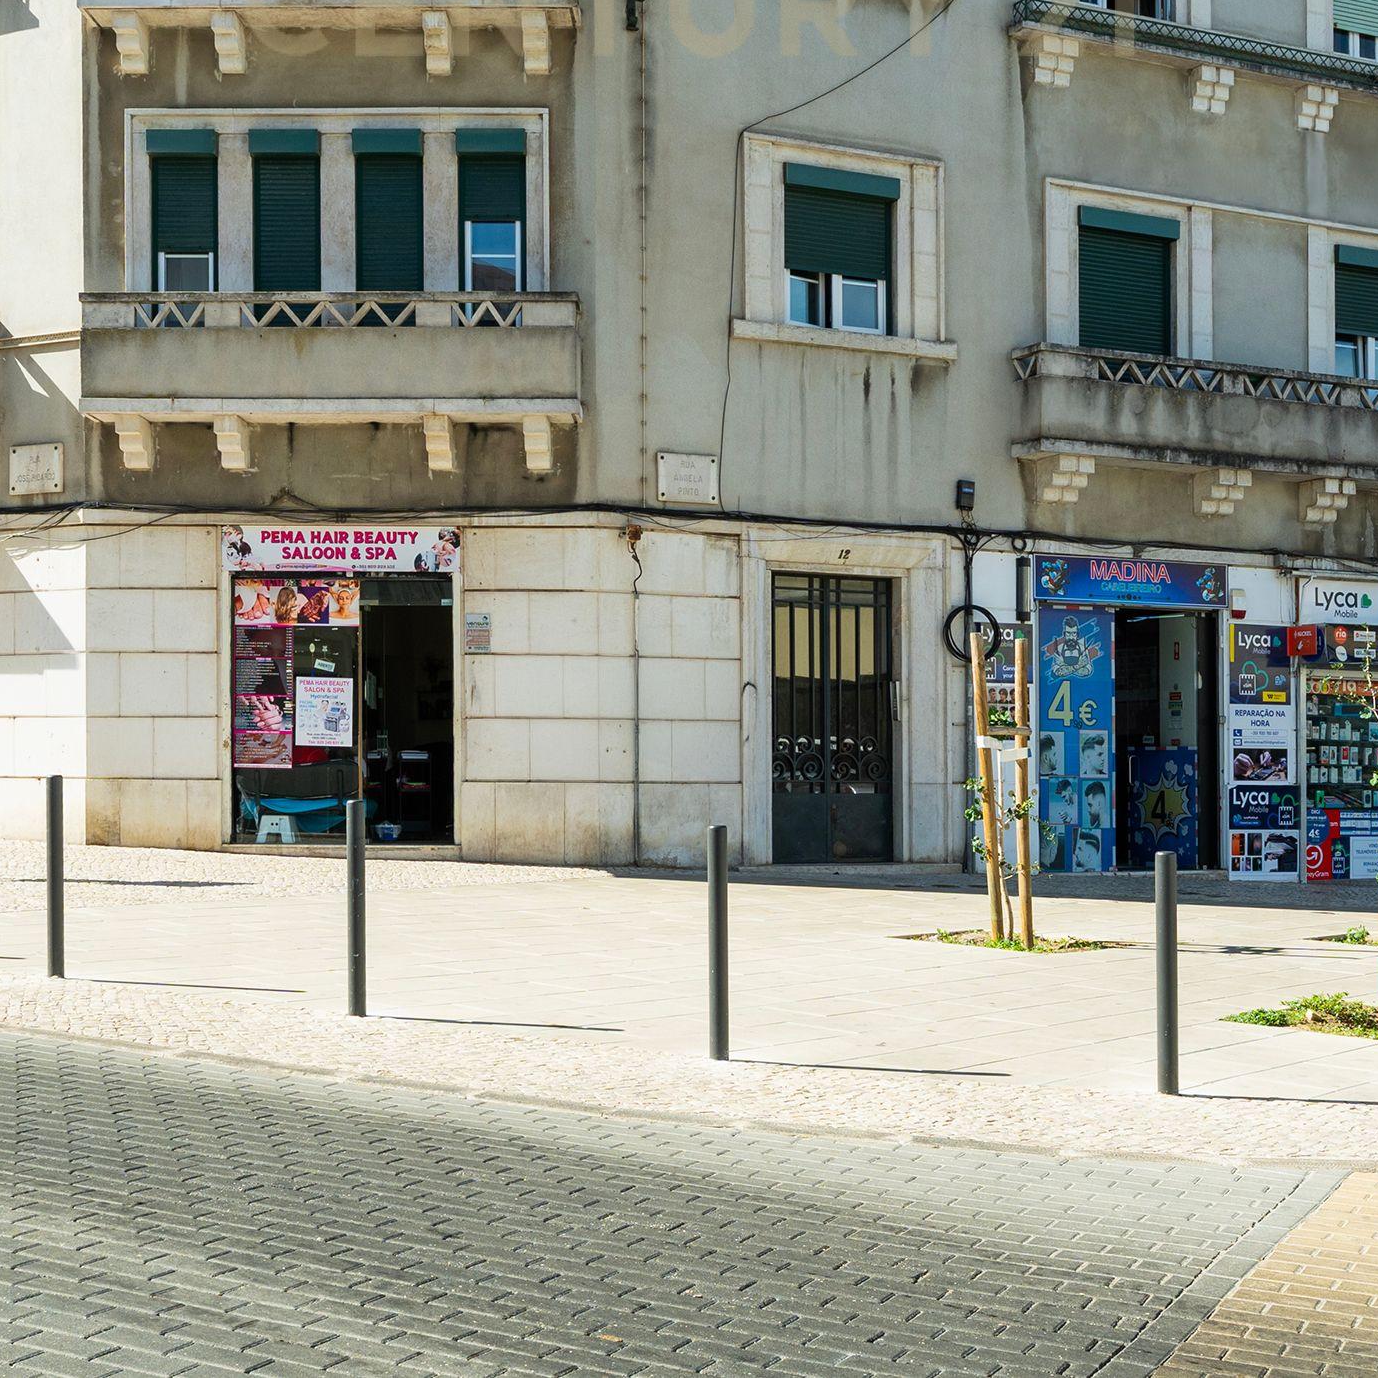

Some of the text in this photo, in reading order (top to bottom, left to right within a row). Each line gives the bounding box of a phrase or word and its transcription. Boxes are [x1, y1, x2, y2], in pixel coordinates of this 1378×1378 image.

[677, 487, 699, 496] PINTO
[261, 530, 419, 545] PEMA HAIR BEAUTY
[282, 546, 397, 560] SALOON & SPA
[837, 549, 851, 560] 12
[1090, 560, 1171, 584] MADINA
[1314, 587, 1358, 611] Lyca
[1334, 609, 1358, 619] Mobile
[981, 625, 1014, 643] Lya
[1238, 631, 1271, 649] Lyca
[1335, 628, 1347, 638] ria
[314, 679, 328, 687] HAIR
[1234, 709, 1274, 718] REPARAÇÃO
[1232, 788, 1269, 808] Lyca
